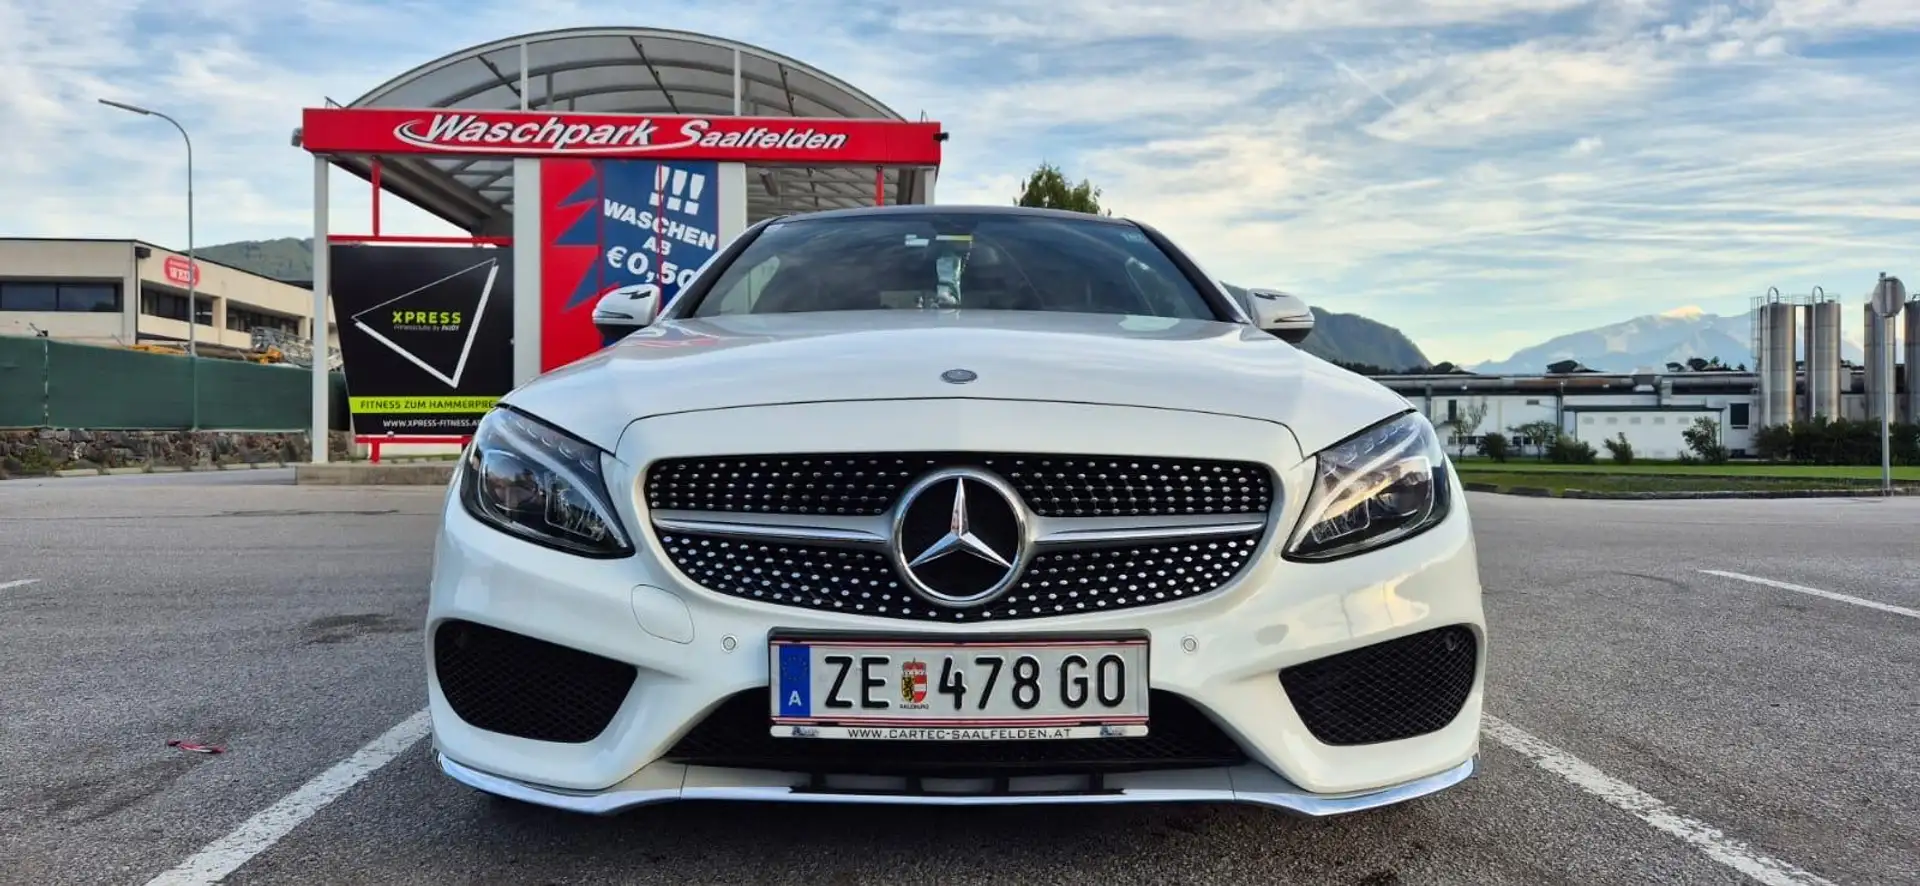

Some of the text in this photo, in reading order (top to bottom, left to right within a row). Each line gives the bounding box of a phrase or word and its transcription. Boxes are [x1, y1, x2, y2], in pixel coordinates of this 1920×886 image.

[424, 113, 847, 150] Waschpark Saalfelden
[603, 198, 717, 251] WASCHEN
[642, 236, 672, 256] AB
[392, 311, 461, 324] XPRESS
[360, 400, 400, 409] FITNESS
[404, 400, 427, 409] ZUM
[825, 656, 889, 708] ZE
[939, 656, 1041, 710] 478
[788, 690, 802, 706] A
[848, 728, 1072, 740] WWW.CARTEC-SAALFELDEN.AT
